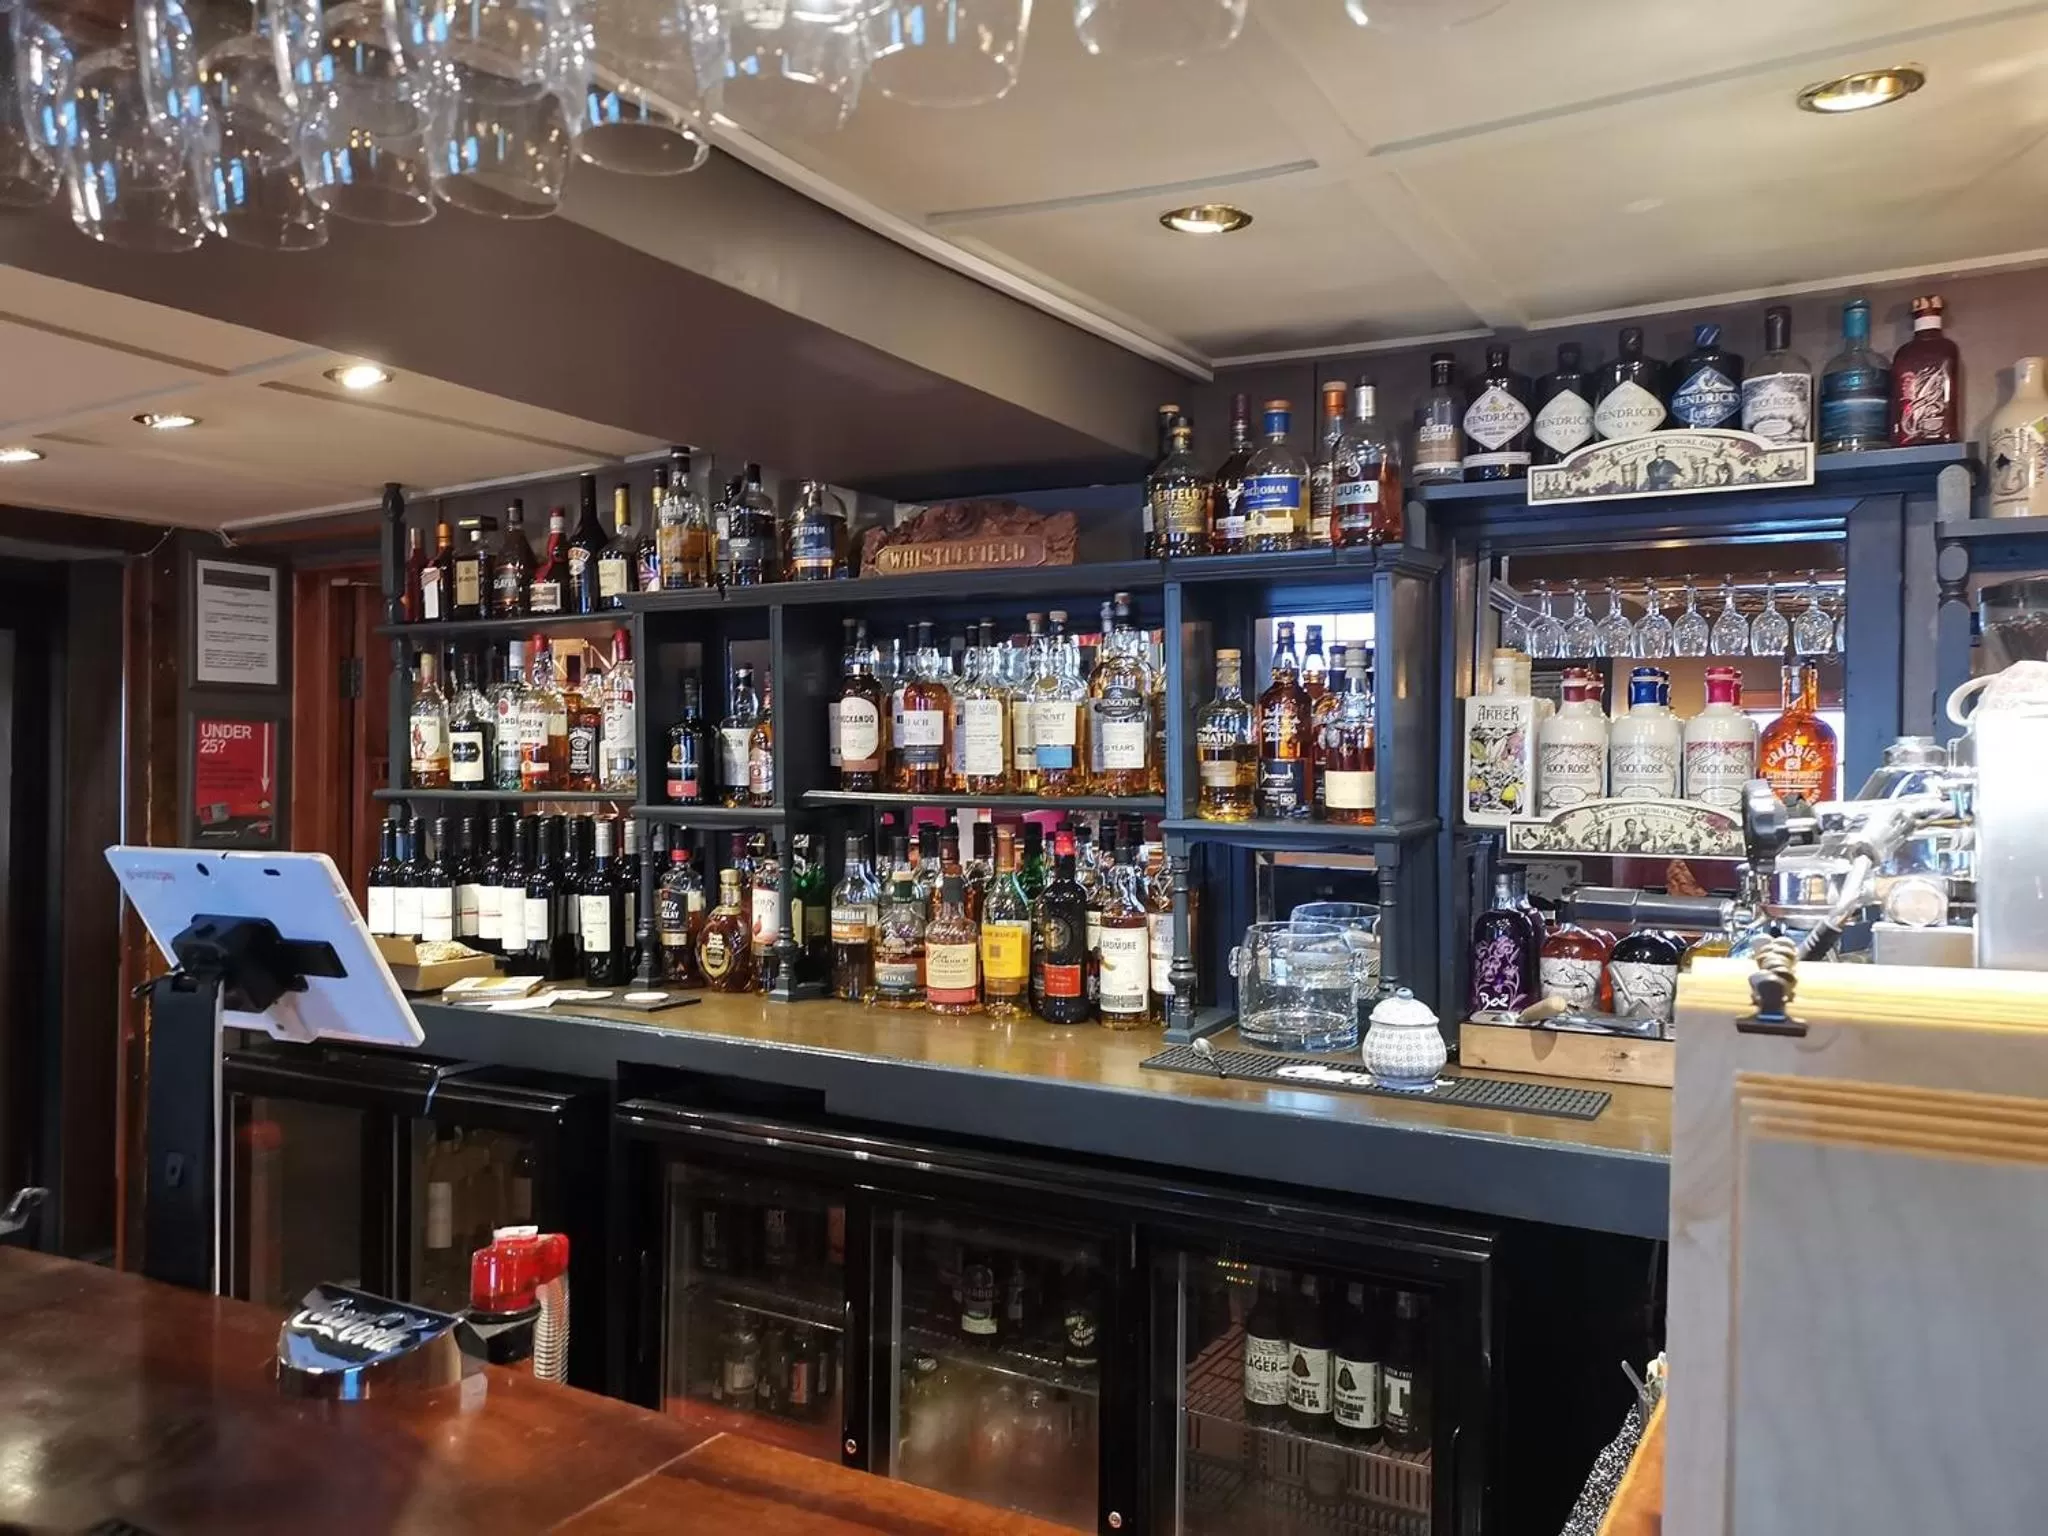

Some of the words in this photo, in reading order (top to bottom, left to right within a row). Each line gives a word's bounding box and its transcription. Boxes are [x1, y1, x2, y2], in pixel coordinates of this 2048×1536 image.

[1337, 483, 1372, 496] JURA
[889, 542, 1026, 569] WHISTLEFIELD
[201, 723, 252, 739] UNDER
[1196, 731, 1237, 744] OMATIN
[200, 739, 227, 753] 25?
[1568, 763, 1590, 774] ROSE
[1641, 763, 1664, 774] ROSE
[1696, 763, 1722, 774] ROCK
[1724, 763, 1745, 774] ROSE
[1246, 1355, 1279, 1373] AGER
